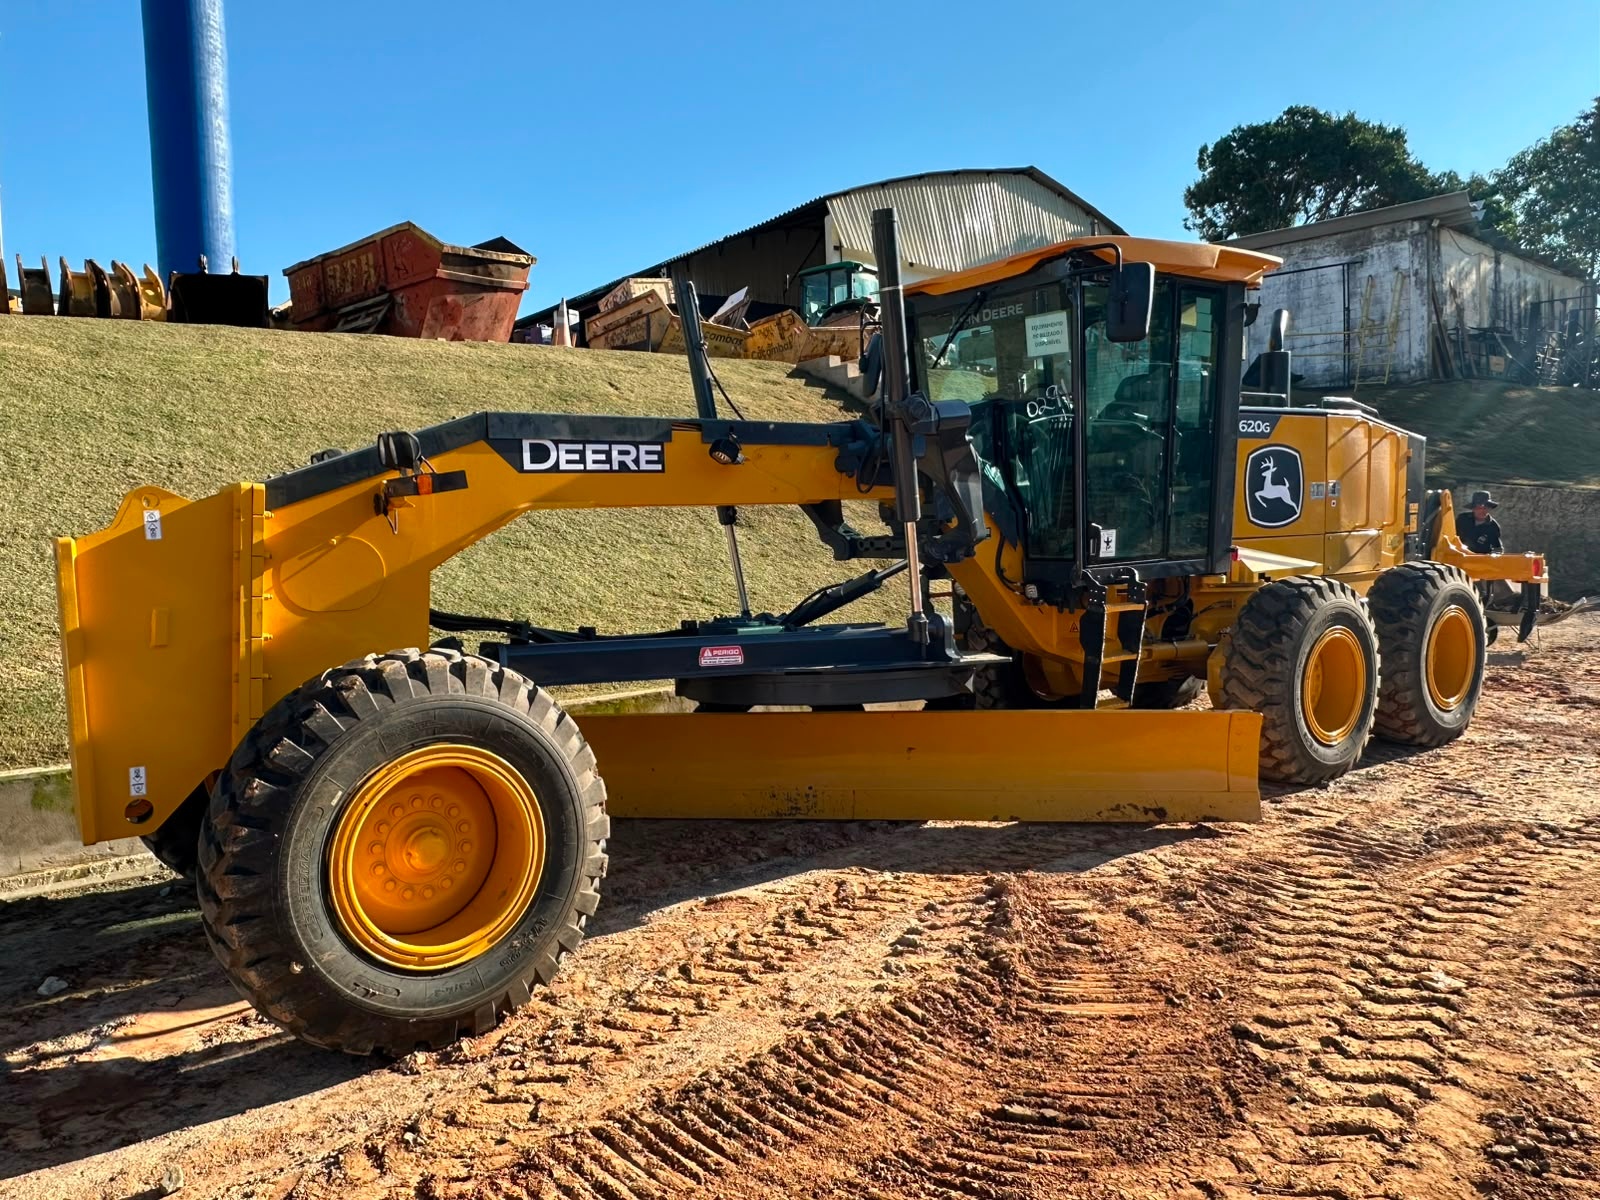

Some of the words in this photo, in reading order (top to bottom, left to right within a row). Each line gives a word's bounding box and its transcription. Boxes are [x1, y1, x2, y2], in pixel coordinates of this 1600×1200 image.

[982, 303, 1024, 322] DEERE
[1238, 419, 1271, 433] 620G
[522, 439, 663, 471] DEERE
